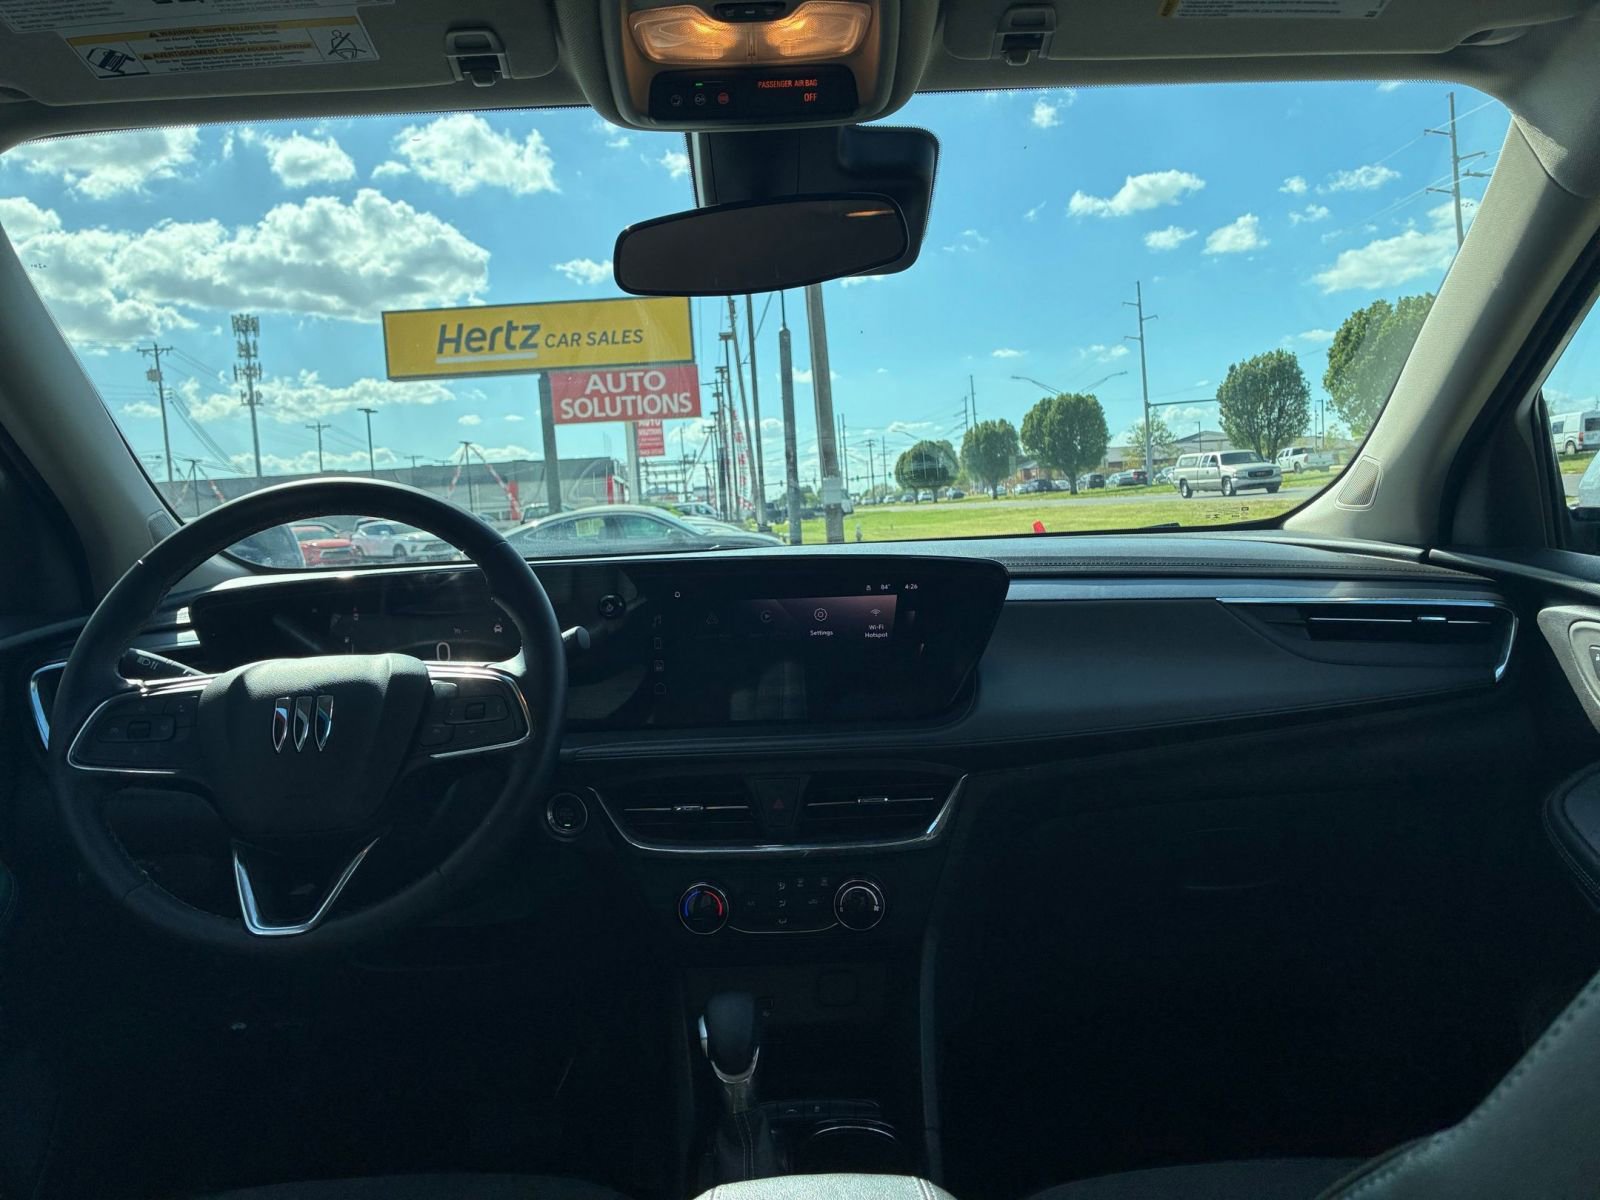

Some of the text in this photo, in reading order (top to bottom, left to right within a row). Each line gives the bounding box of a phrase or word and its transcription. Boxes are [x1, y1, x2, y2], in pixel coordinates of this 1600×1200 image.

[757, 79, 792, 88] PASSENGER
[803, 92, 817, 102] OFF
[437, 320, 644, 354] Hertz CAR SALES
[584, 371, 666, 395] AUTO
[560, 392, 692, 419] SOLUTIONS
[809, 629, 834, 637] Settings
[864, 631, 888, 639] Hotspot
